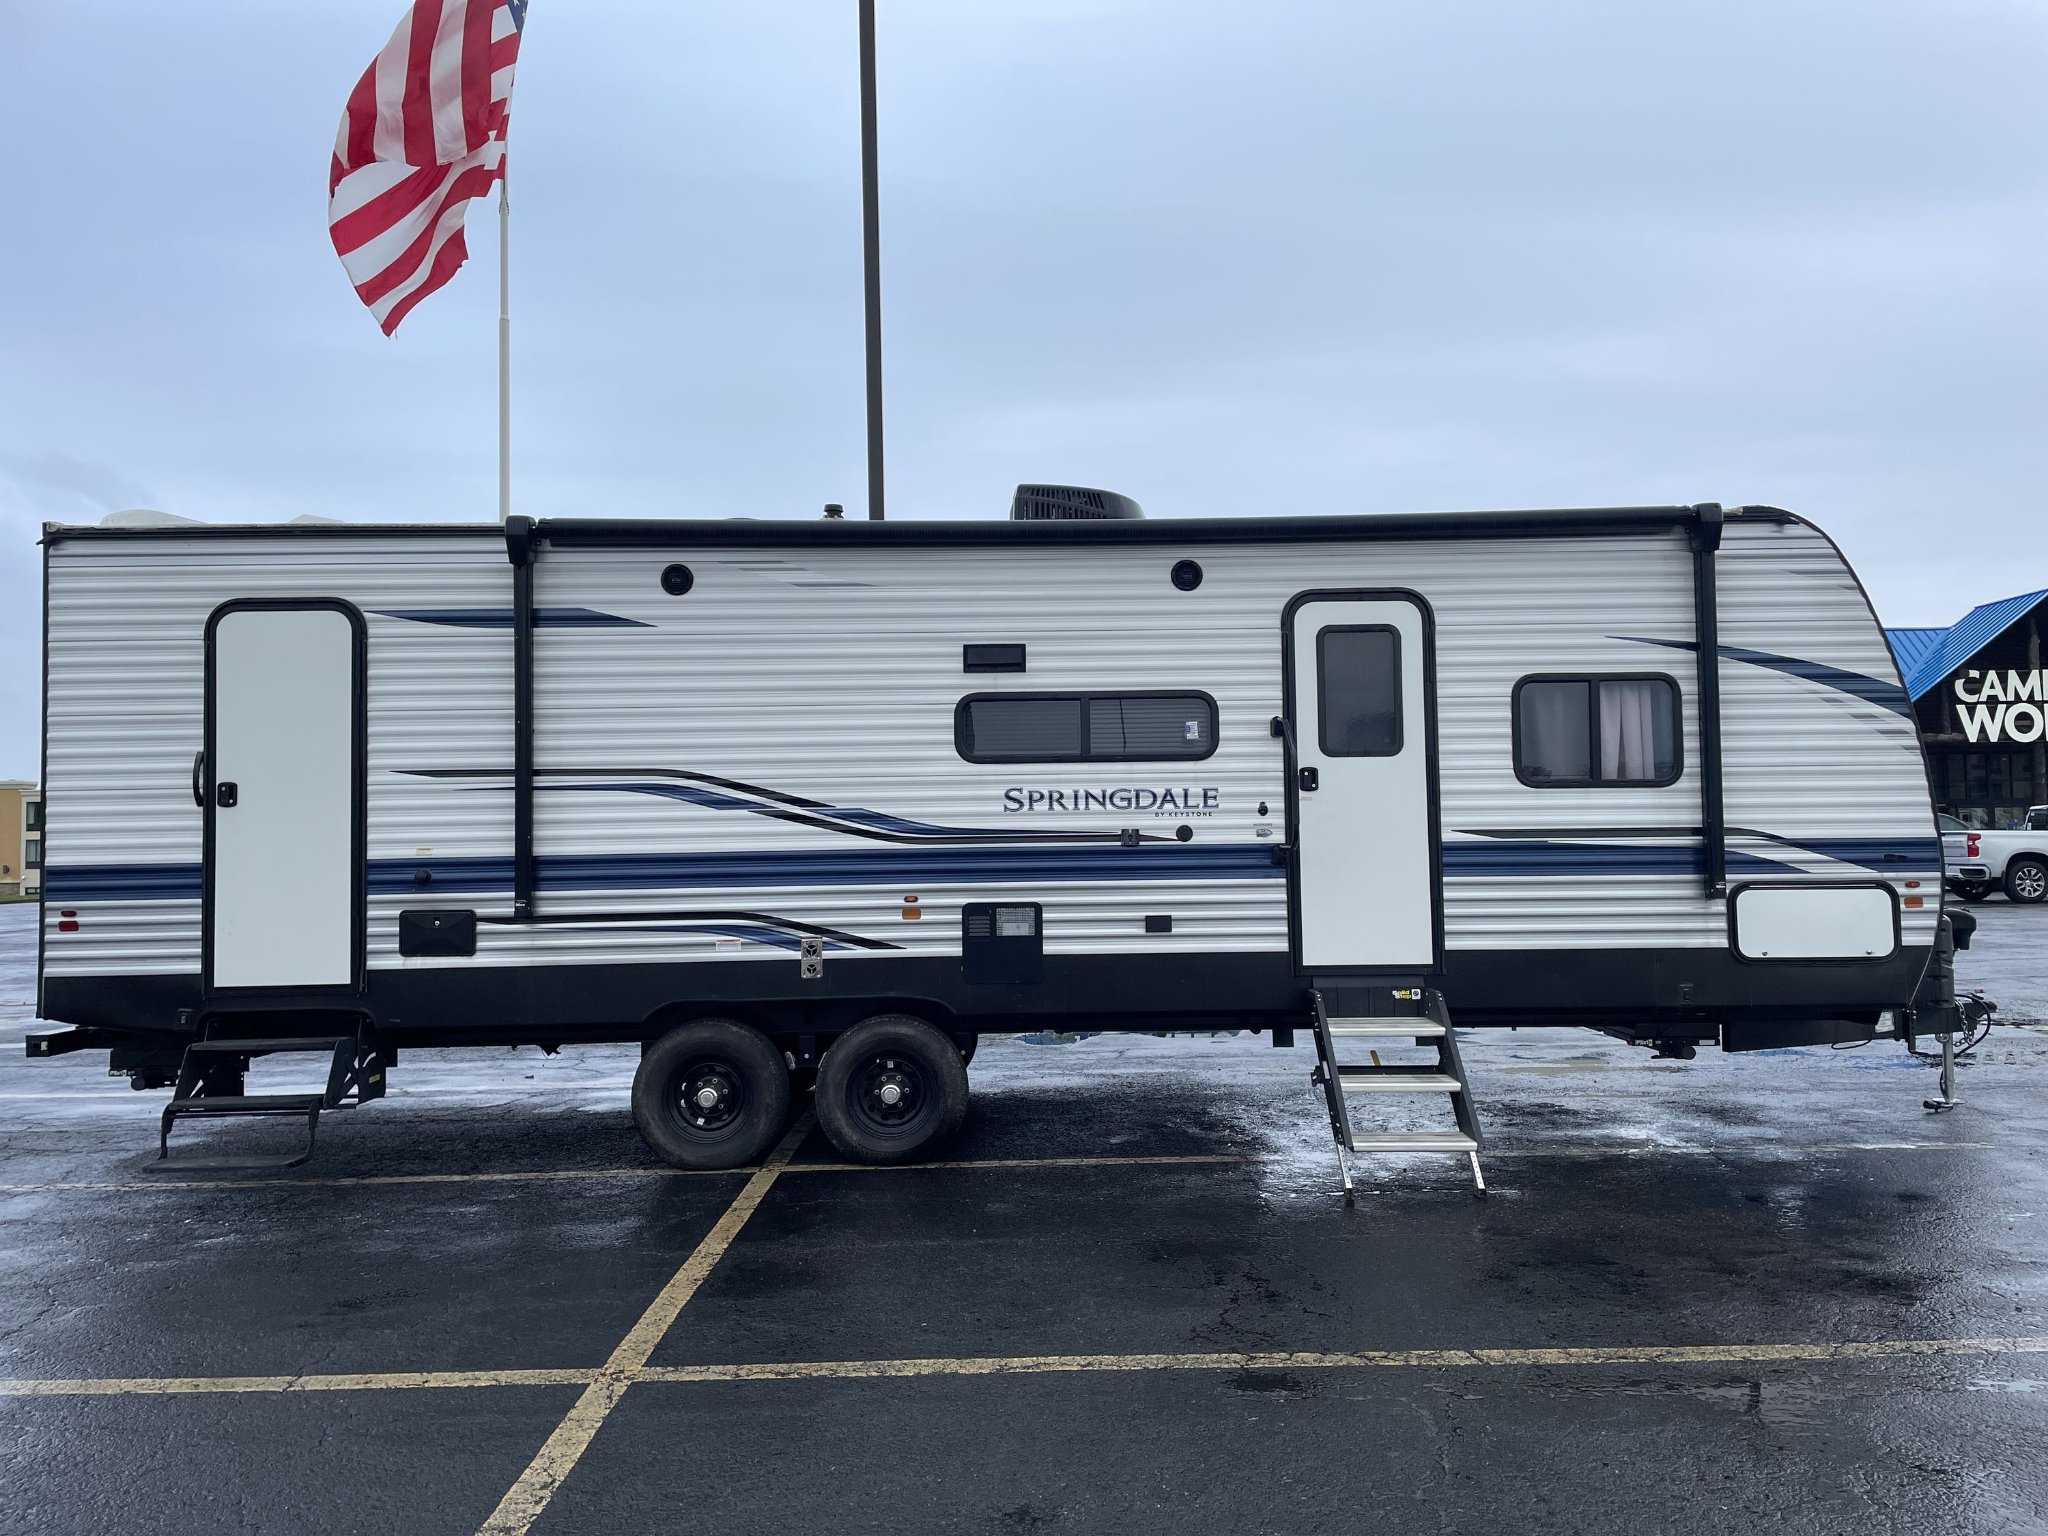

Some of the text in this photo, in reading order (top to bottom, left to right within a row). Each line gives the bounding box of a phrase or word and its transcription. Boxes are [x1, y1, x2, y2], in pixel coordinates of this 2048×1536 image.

[1955, 669, 2048, 702] CAM
[1956, 703, 2048, 742] WO
[1003, 787, 1219, 812] SPRINGDALE
